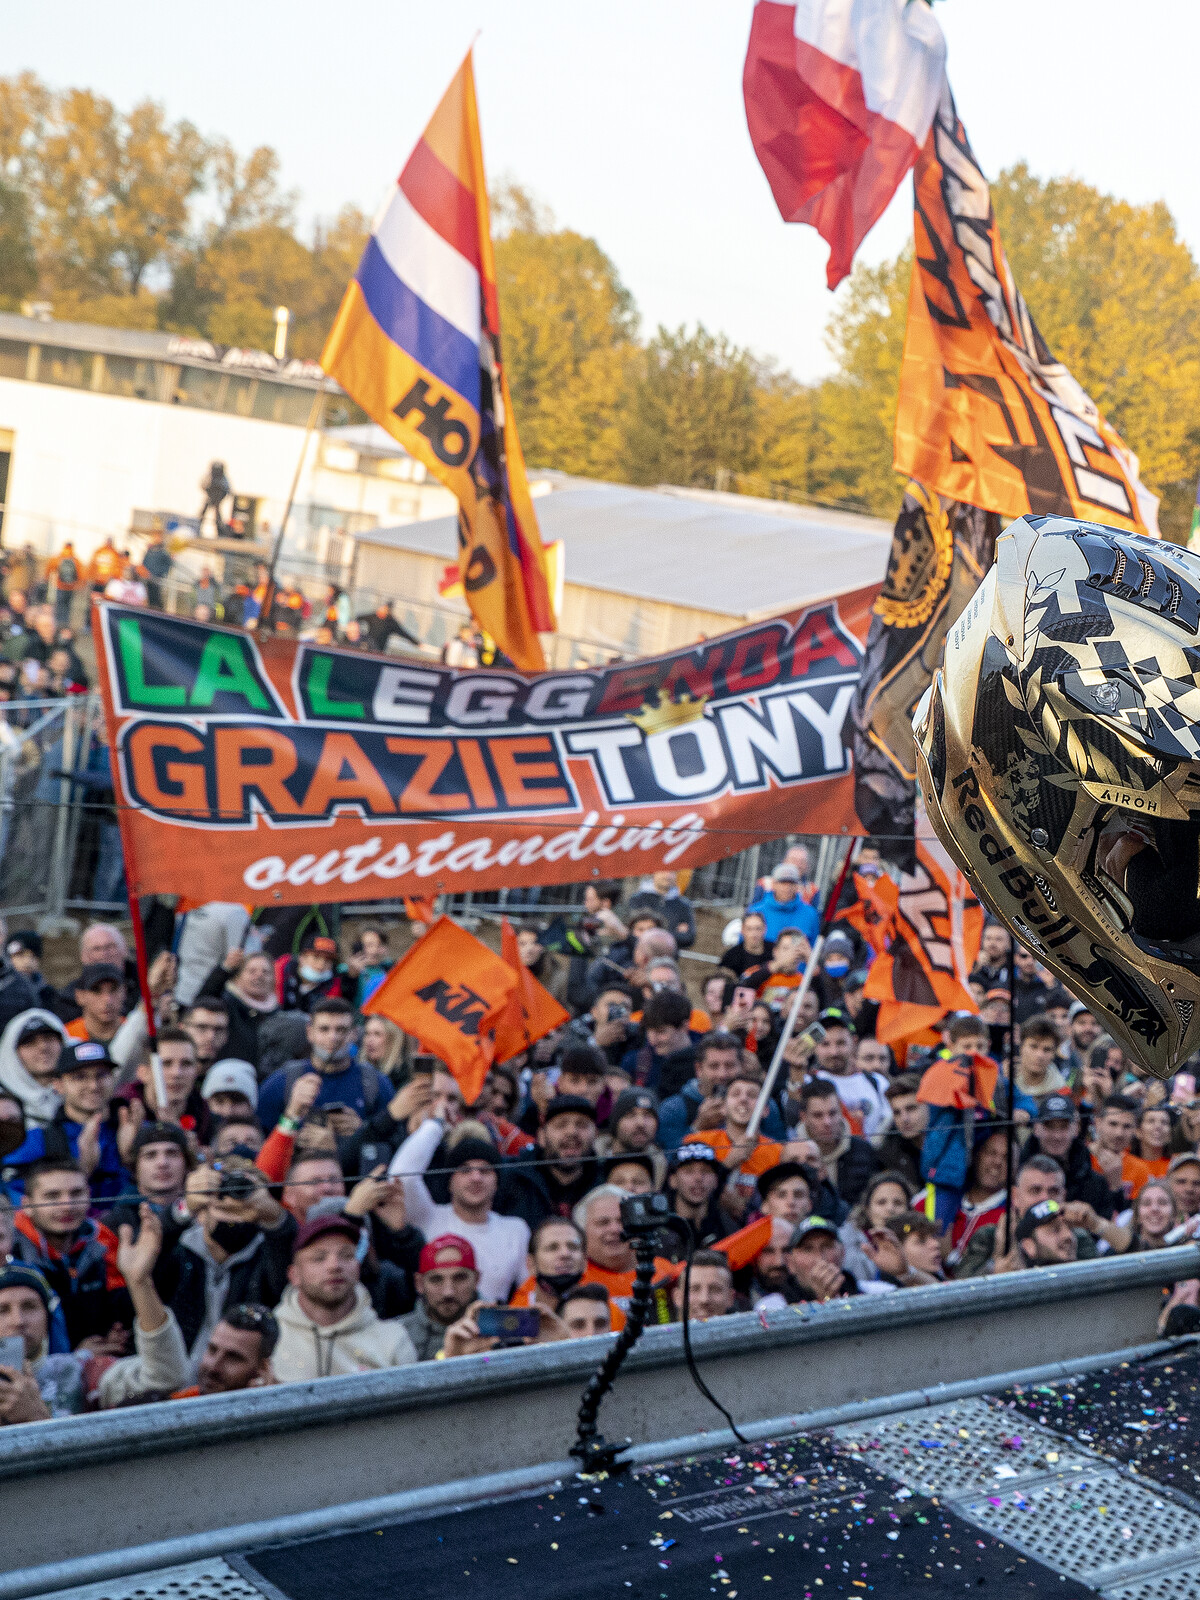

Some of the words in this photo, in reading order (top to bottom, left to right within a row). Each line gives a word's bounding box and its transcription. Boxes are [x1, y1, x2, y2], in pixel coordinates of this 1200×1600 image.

[118, 617, 271, 711] LA
[307, 612, 858, 723] LEGGENDA
[129, 724, 570, 819] GRAZIE
[567, 685, 857, 801] TONY
[1100, 789, 1158, 812] AIROH
[243, 810, 708, 891] outstanding
[951, 766, 1017, 866] Red
[999, 863, 1082, 949] Bull
